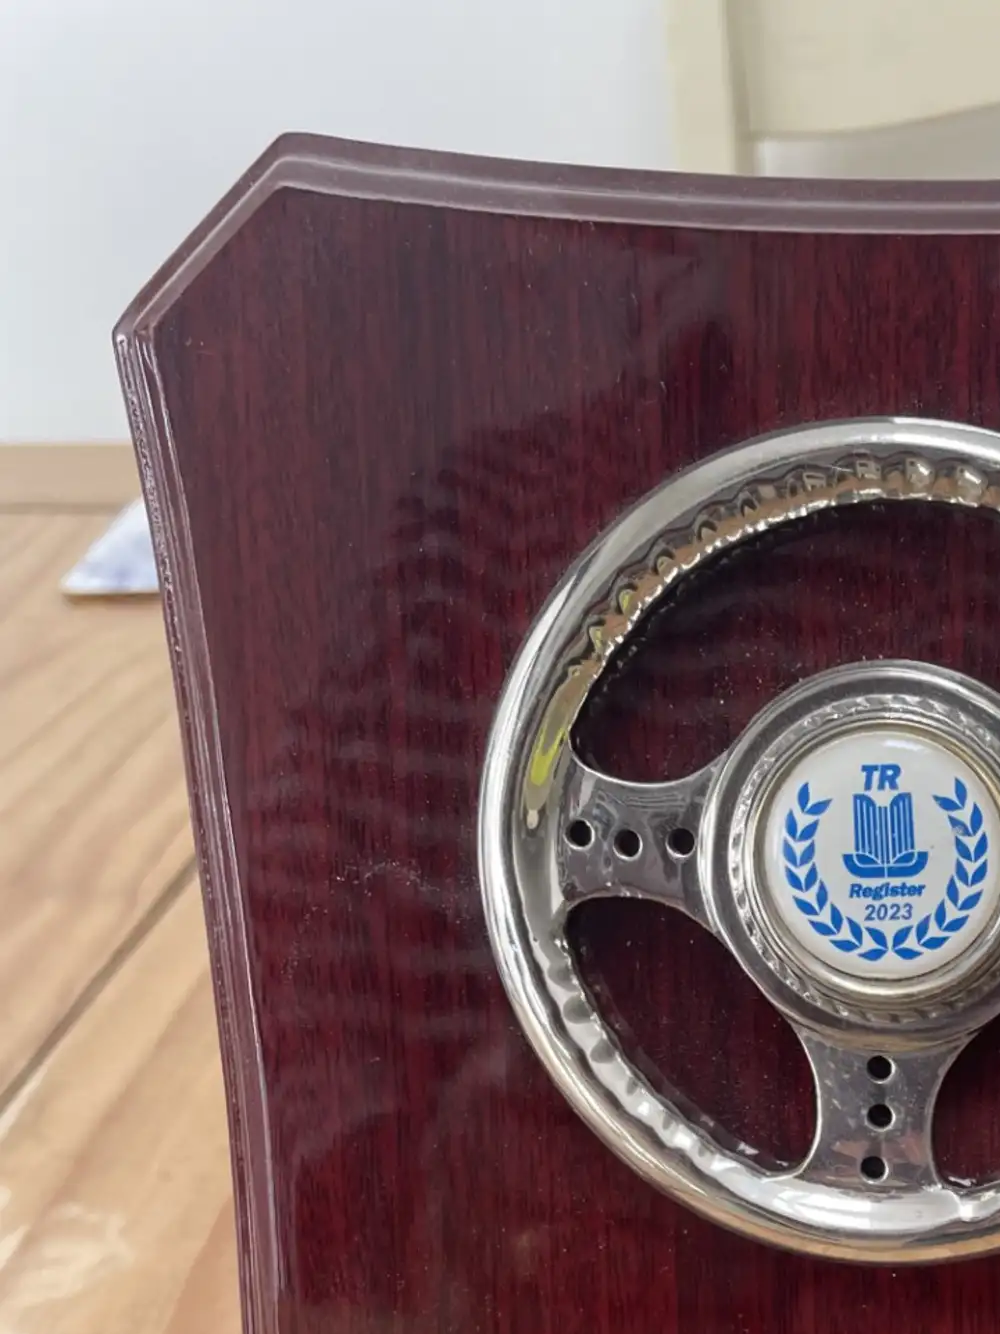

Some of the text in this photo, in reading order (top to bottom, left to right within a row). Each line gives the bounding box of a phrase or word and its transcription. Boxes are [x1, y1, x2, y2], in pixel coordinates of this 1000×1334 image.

[861, 763, 902, 791] TR
[849, 882, 926, 900] Register
[864, 903, 913, 921] 2023
